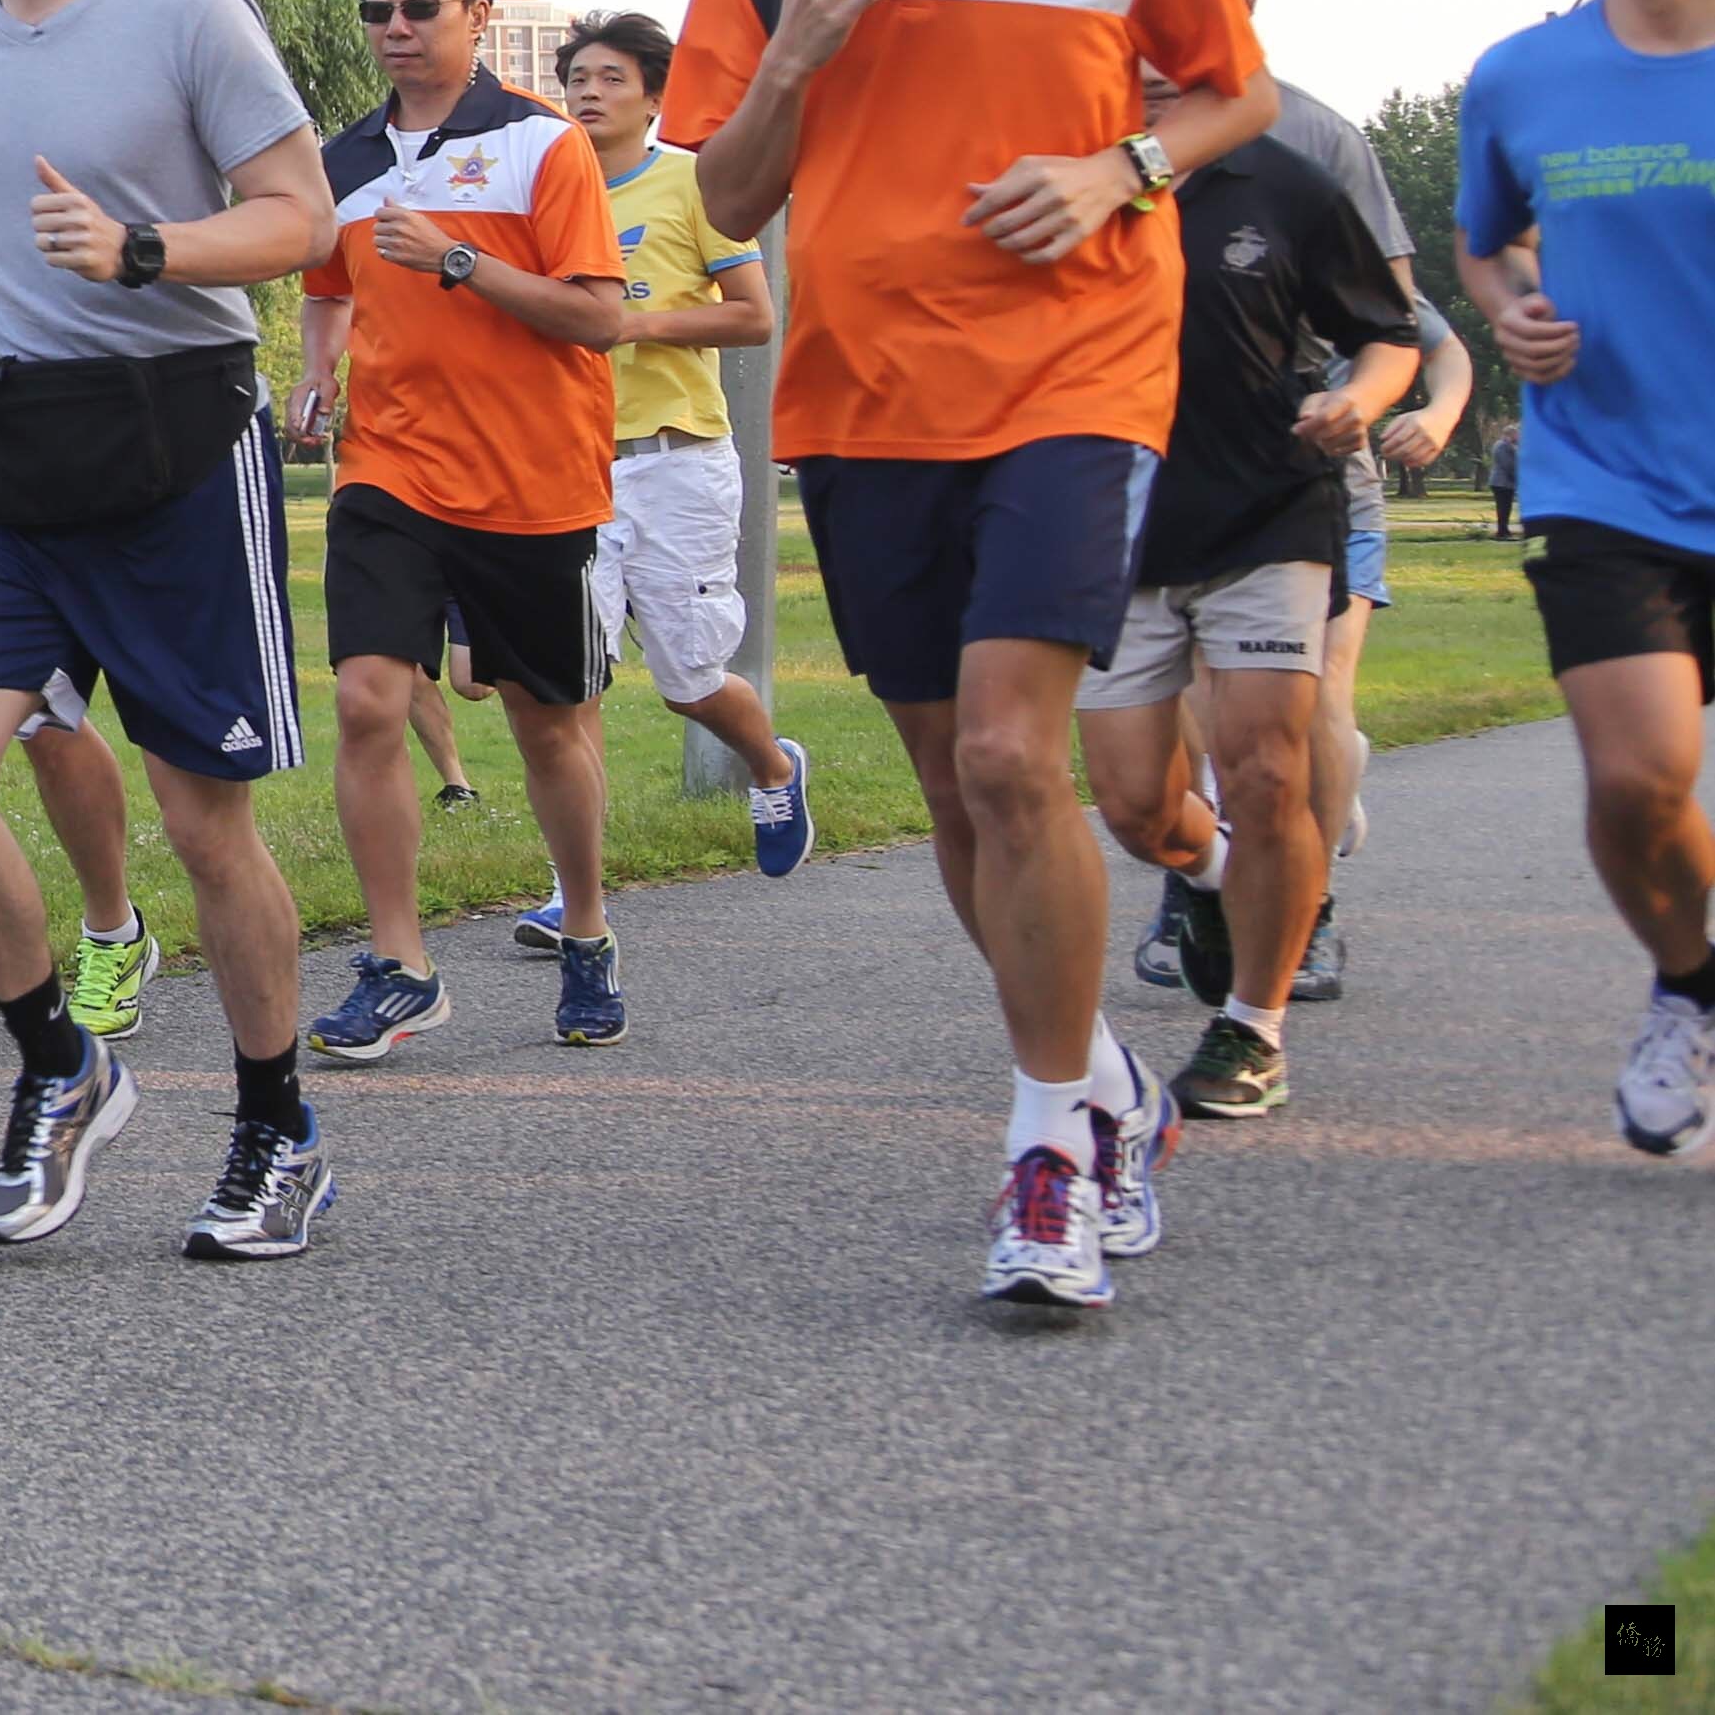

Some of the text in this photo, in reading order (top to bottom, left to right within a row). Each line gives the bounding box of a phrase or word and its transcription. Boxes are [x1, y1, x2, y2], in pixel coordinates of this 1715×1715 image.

[1587, 142, 1689, 163] balance
[1239, 640, 1306, 654] MARINE
[221, 736, 263, 752] adidas
